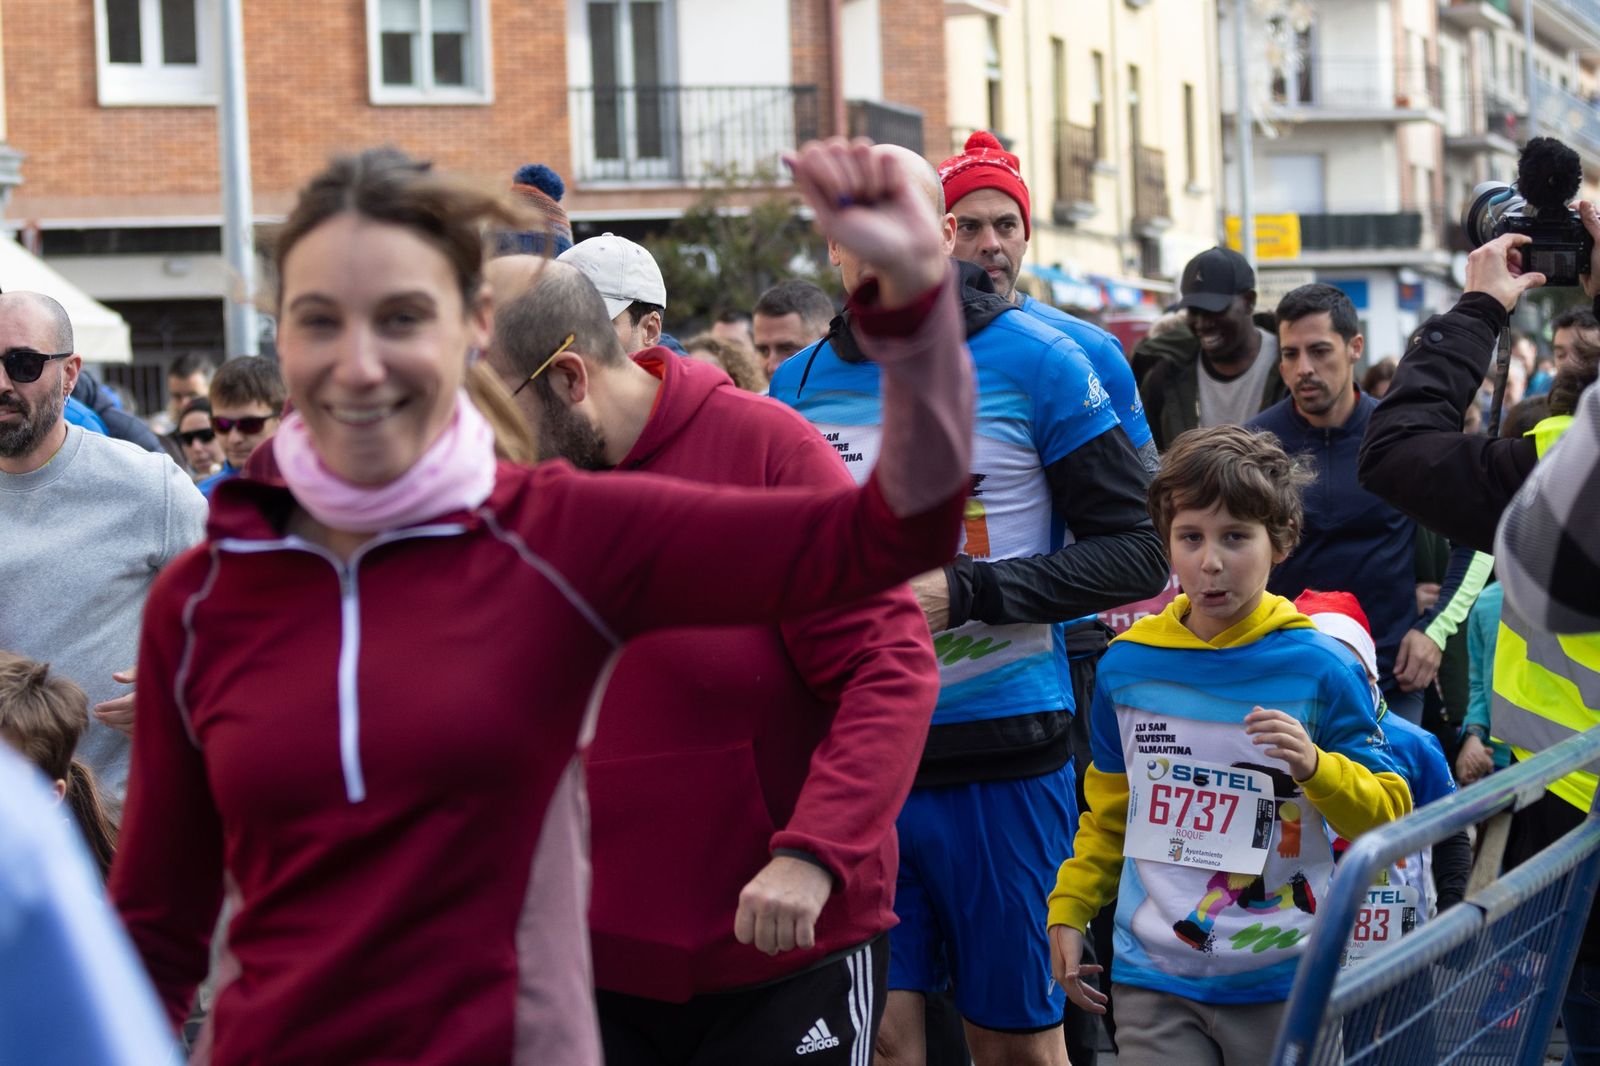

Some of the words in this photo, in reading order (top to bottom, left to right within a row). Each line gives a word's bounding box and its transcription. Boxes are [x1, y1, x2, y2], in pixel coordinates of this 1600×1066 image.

[823, 433, 839, 441] AN
[1148, 722, 1167, 732] SAN
[1135, 734, 1176, 743] SILVESTRE
[1138, 745, 1192, 755] ALMANTINA
[1172, 764, 1262, 793] SETEL
[1149, 784, 1240, 834] 6737
[1175, 828, 1205, 841] ROQUE
[1185, 847, 1223, 859] Ayuntamiento
[1191, 856, 1221, 867] Salamanca
[1364, 891, 1406, 904] TEL
[1354, 909, 1389, 941] 83
[796, 1036, 840, 1055] adidas
